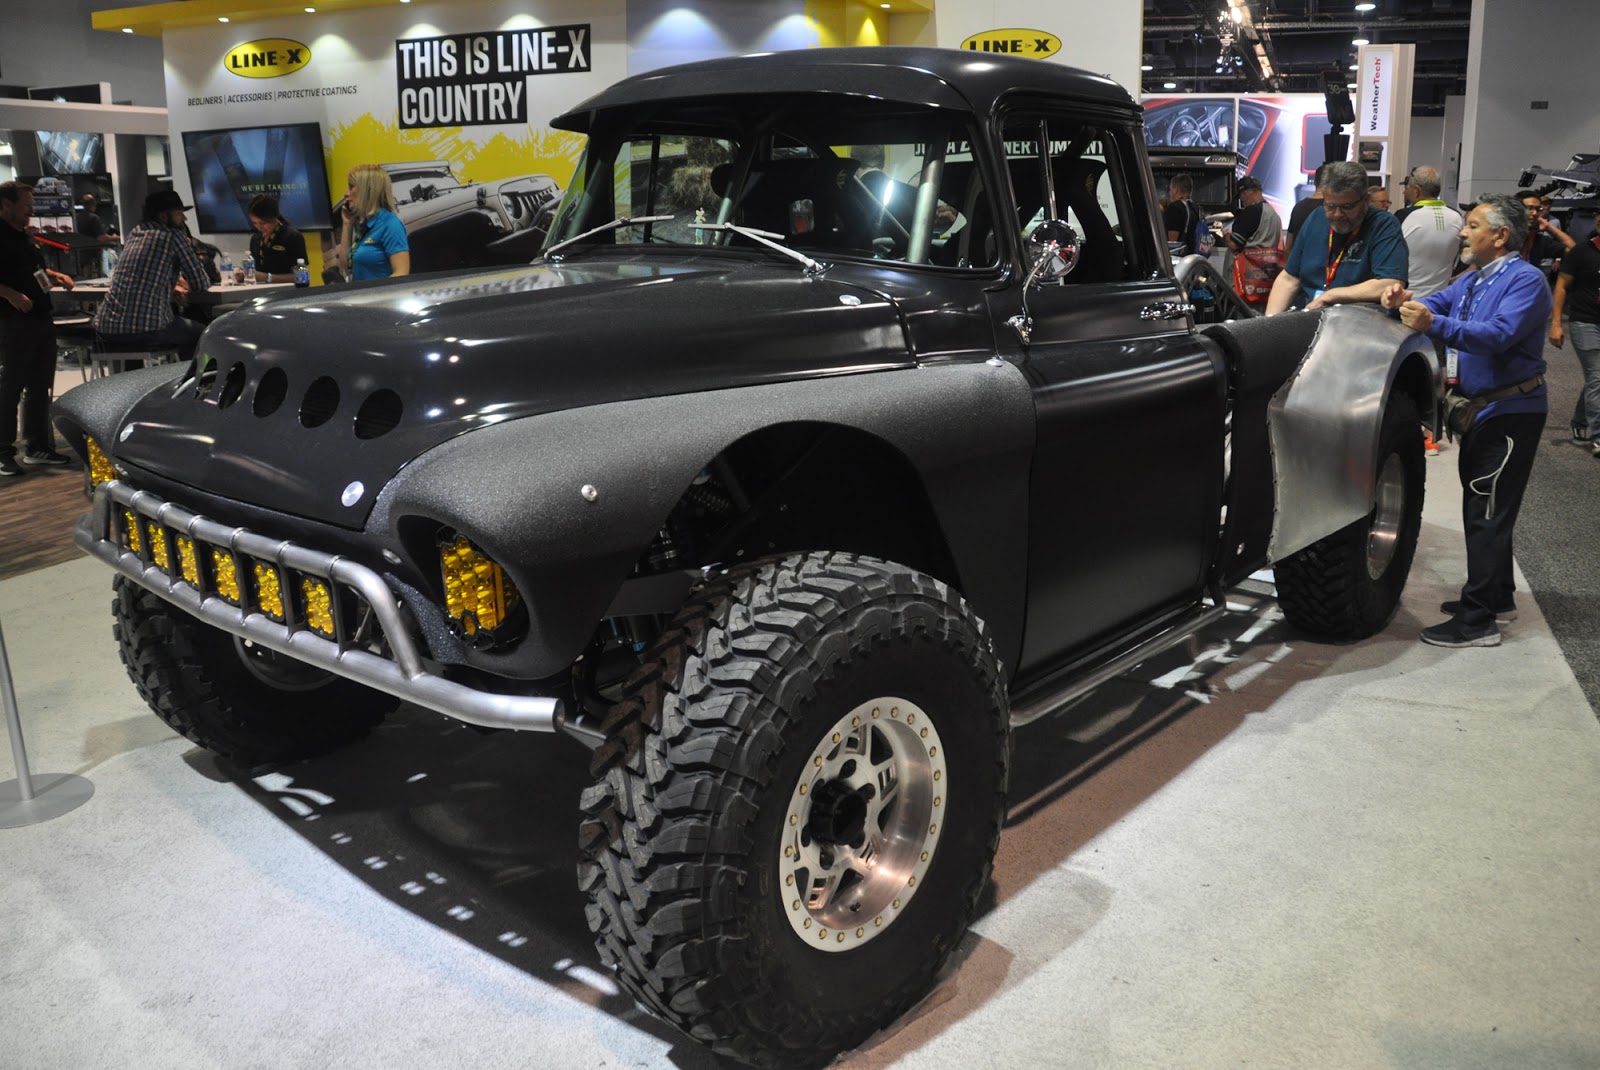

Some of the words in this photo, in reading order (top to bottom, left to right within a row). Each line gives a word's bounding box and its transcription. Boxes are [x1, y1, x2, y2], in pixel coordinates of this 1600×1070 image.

[399, 39, 458, 79] THIS
[465, 36, 490, 75] IS
[497, 29, 587, 72] LINE-X
[188, 96, 222, 106] BEDLINERS
[227, 92, 272, 103] ACCESSORIES
[277, 88, 320, 99] PROTECTIVE
[321, 85, 357, 95] COATINGS
[402, 81, 523, 125] COUNTRY
